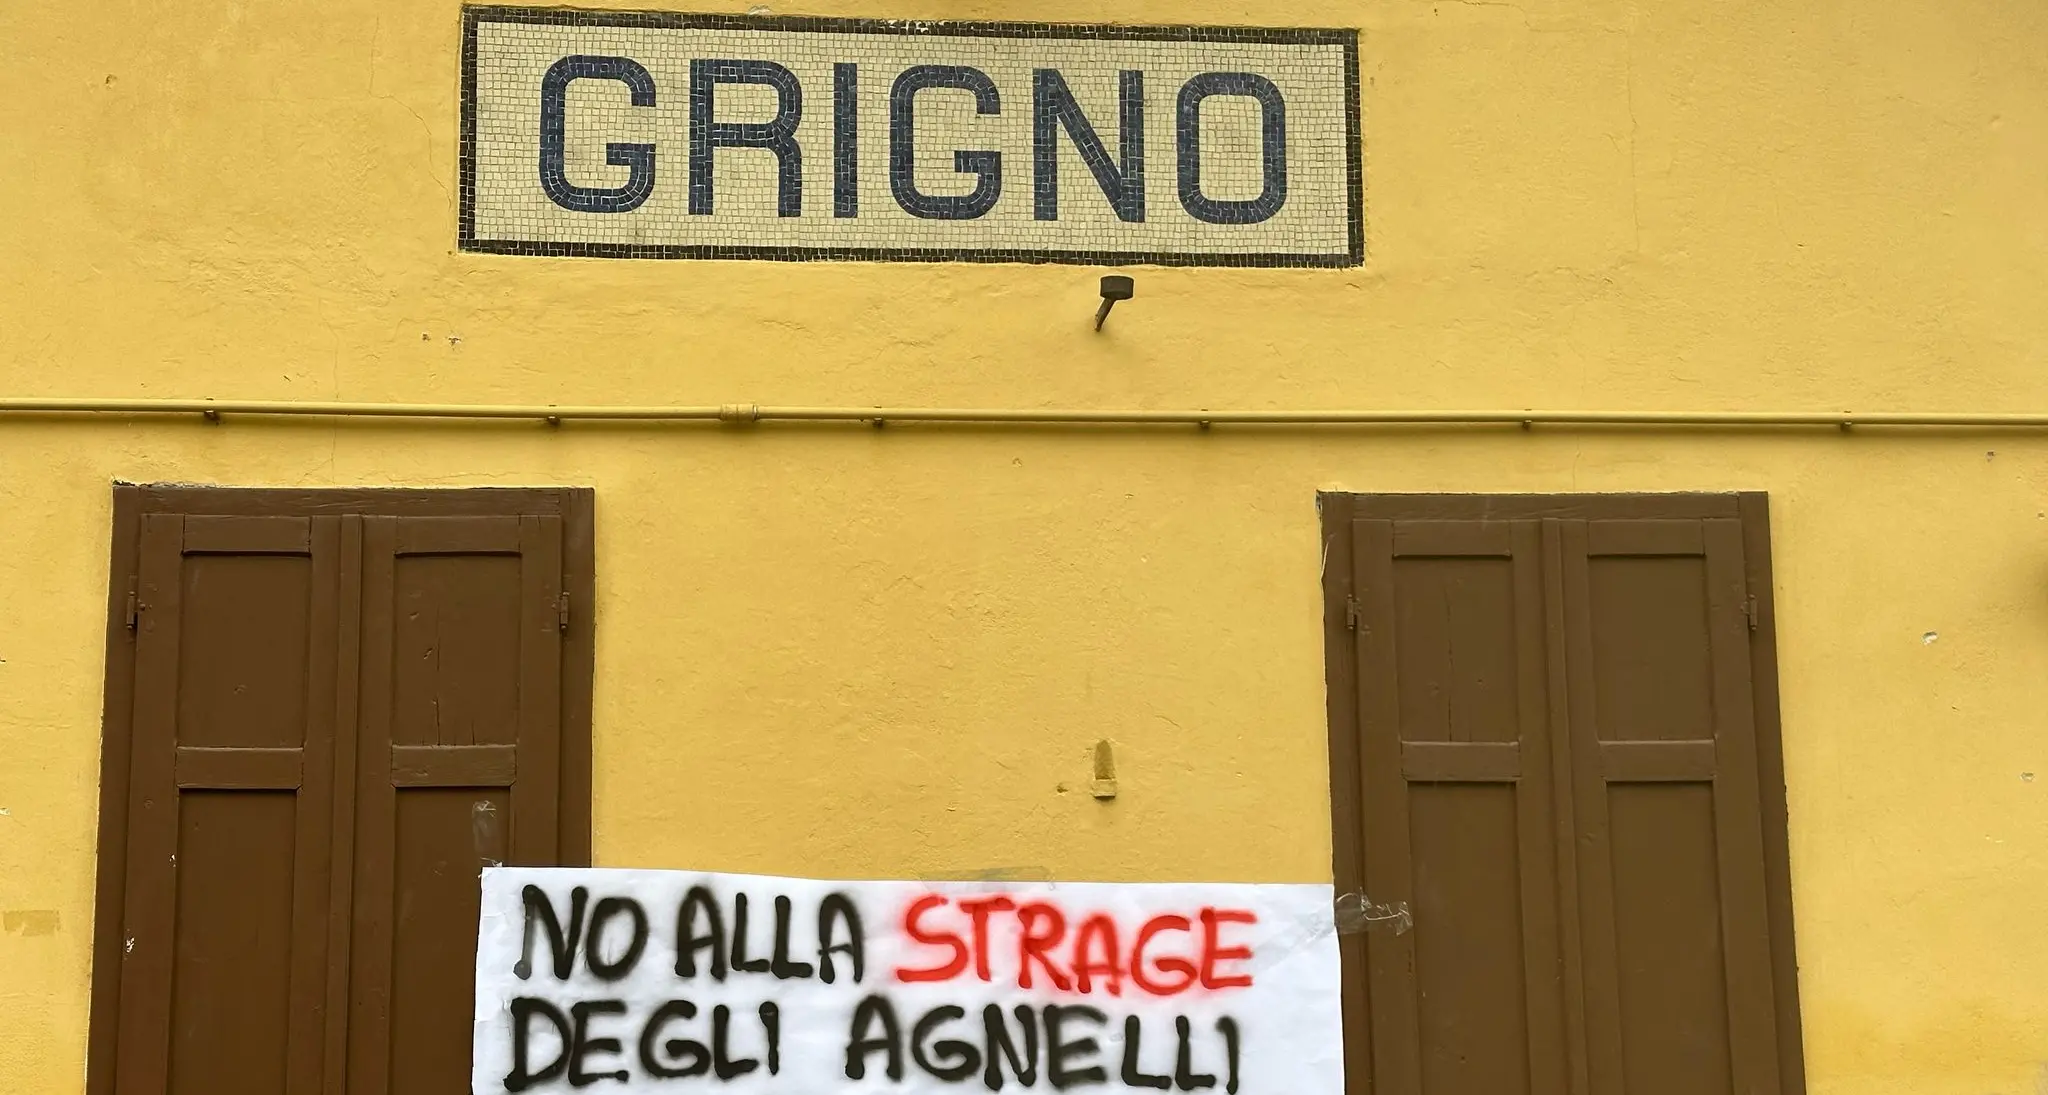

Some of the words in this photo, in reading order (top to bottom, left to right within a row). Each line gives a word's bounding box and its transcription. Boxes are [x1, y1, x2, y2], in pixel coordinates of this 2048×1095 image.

[539, 54, 1287, 224] GRIGNO
[512, 883, 650, 983] NO
[673, 884, 865, 984] ALLA
[894, 892, 1257, 998] STRAGE
[503, 997, 780, 1092] DEGLI
[844, 994, 1240, 1095] AGNELLI
